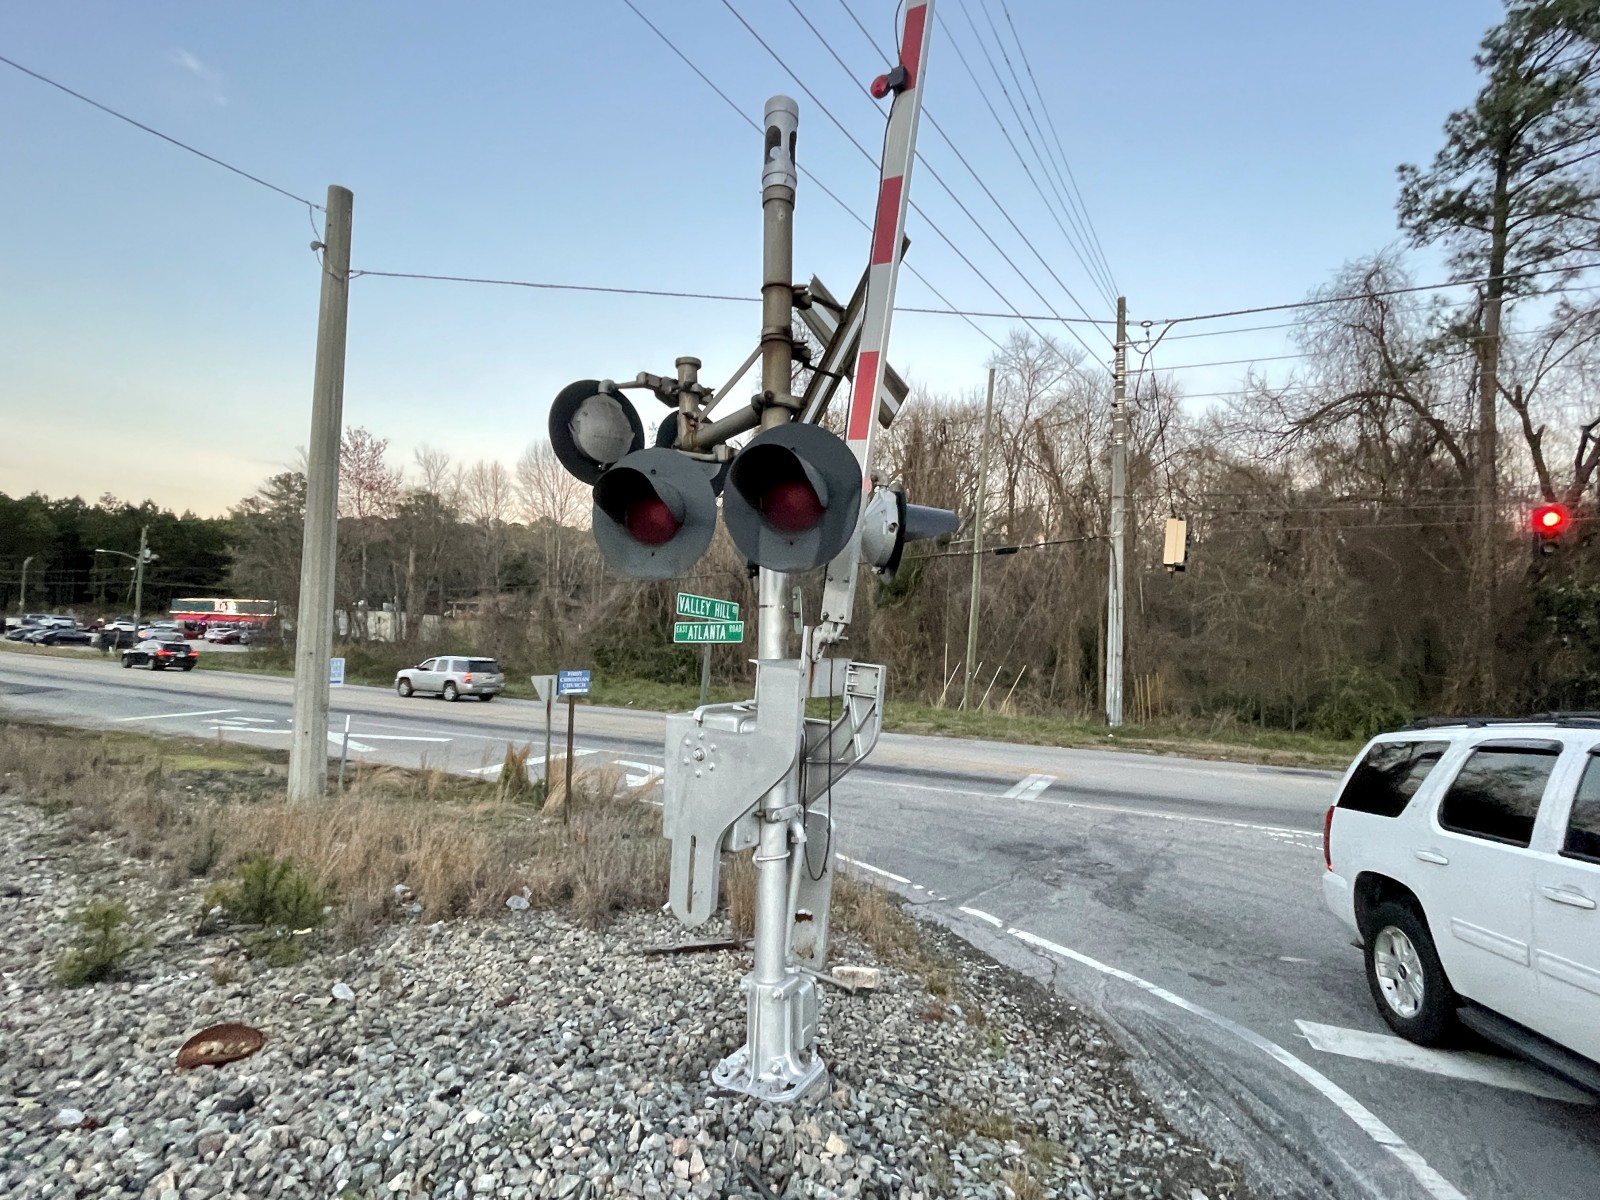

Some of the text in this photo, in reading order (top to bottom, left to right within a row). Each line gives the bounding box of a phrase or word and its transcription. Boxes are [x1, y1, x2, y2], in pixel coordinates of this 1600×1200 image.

[679, 596, 711, 615] VALLEY
[714, 602, 730, 619] HILL
[676, 624, 742, 640] EAST ATLANTA ROAD
